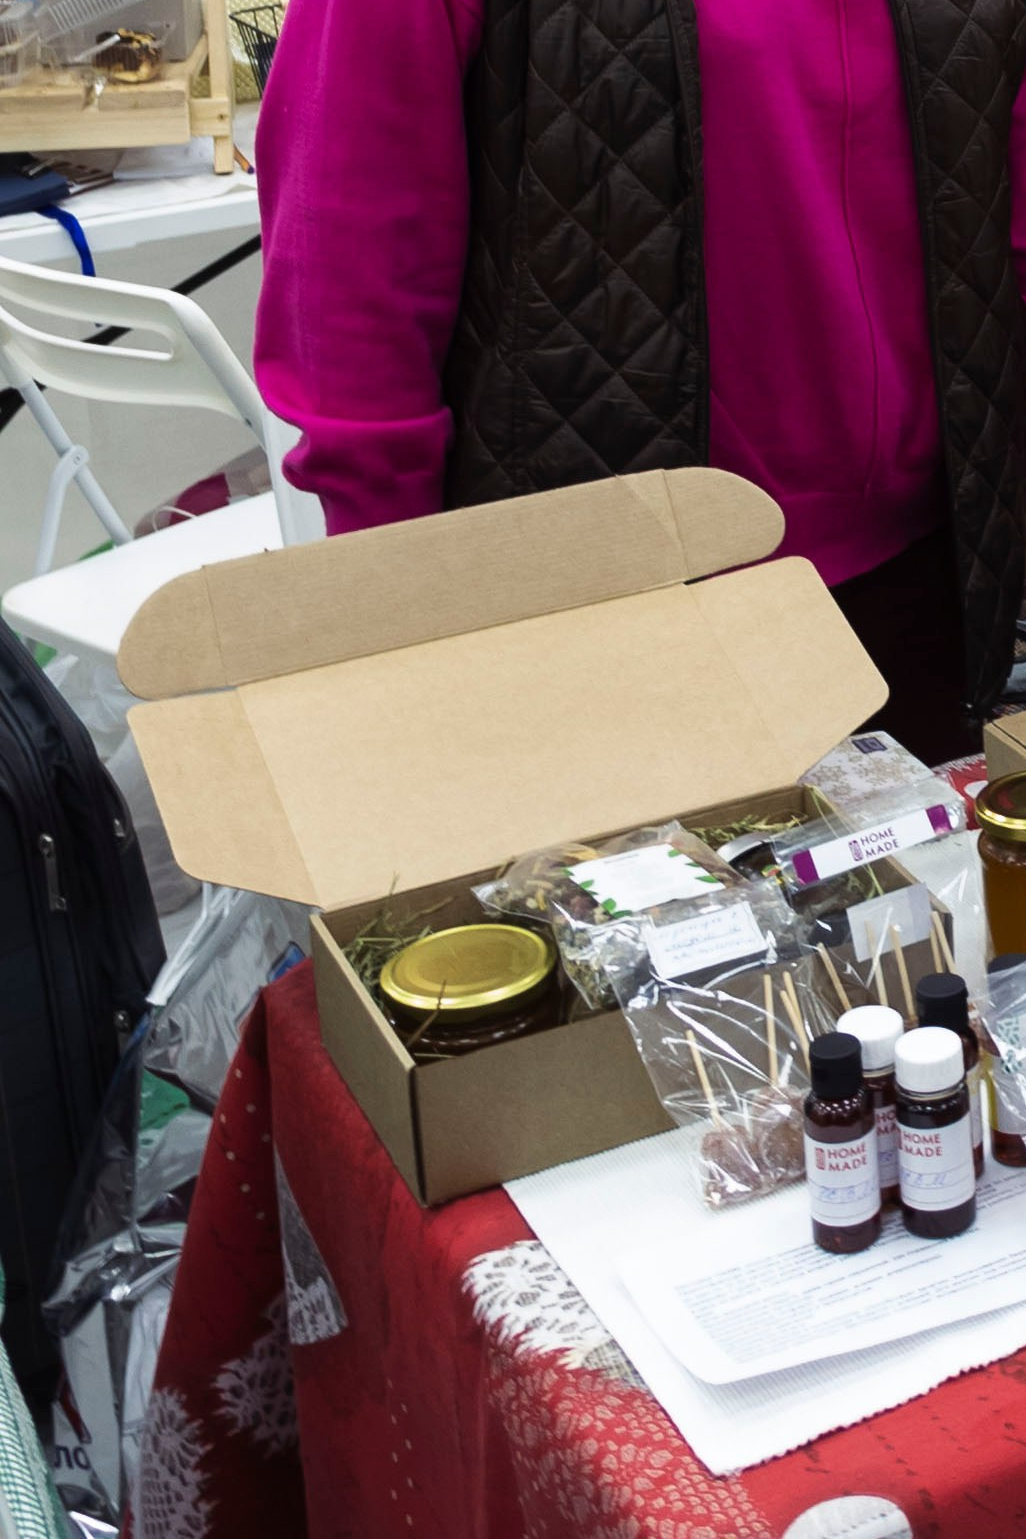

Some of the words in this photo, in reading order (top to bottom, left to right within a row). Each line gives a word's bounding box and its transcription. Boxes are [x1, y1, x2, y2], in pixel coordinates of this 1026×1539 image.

[861, 827, 896, 846] HOME
[865, 839, 900, 858] MADE
[904, 1131, 942, 1145] HOME
[827, 1143, 867, 1159] HOME
[904, 1145, 943, 1158] MADE
[828, 1156, 868, 1172] MADE
